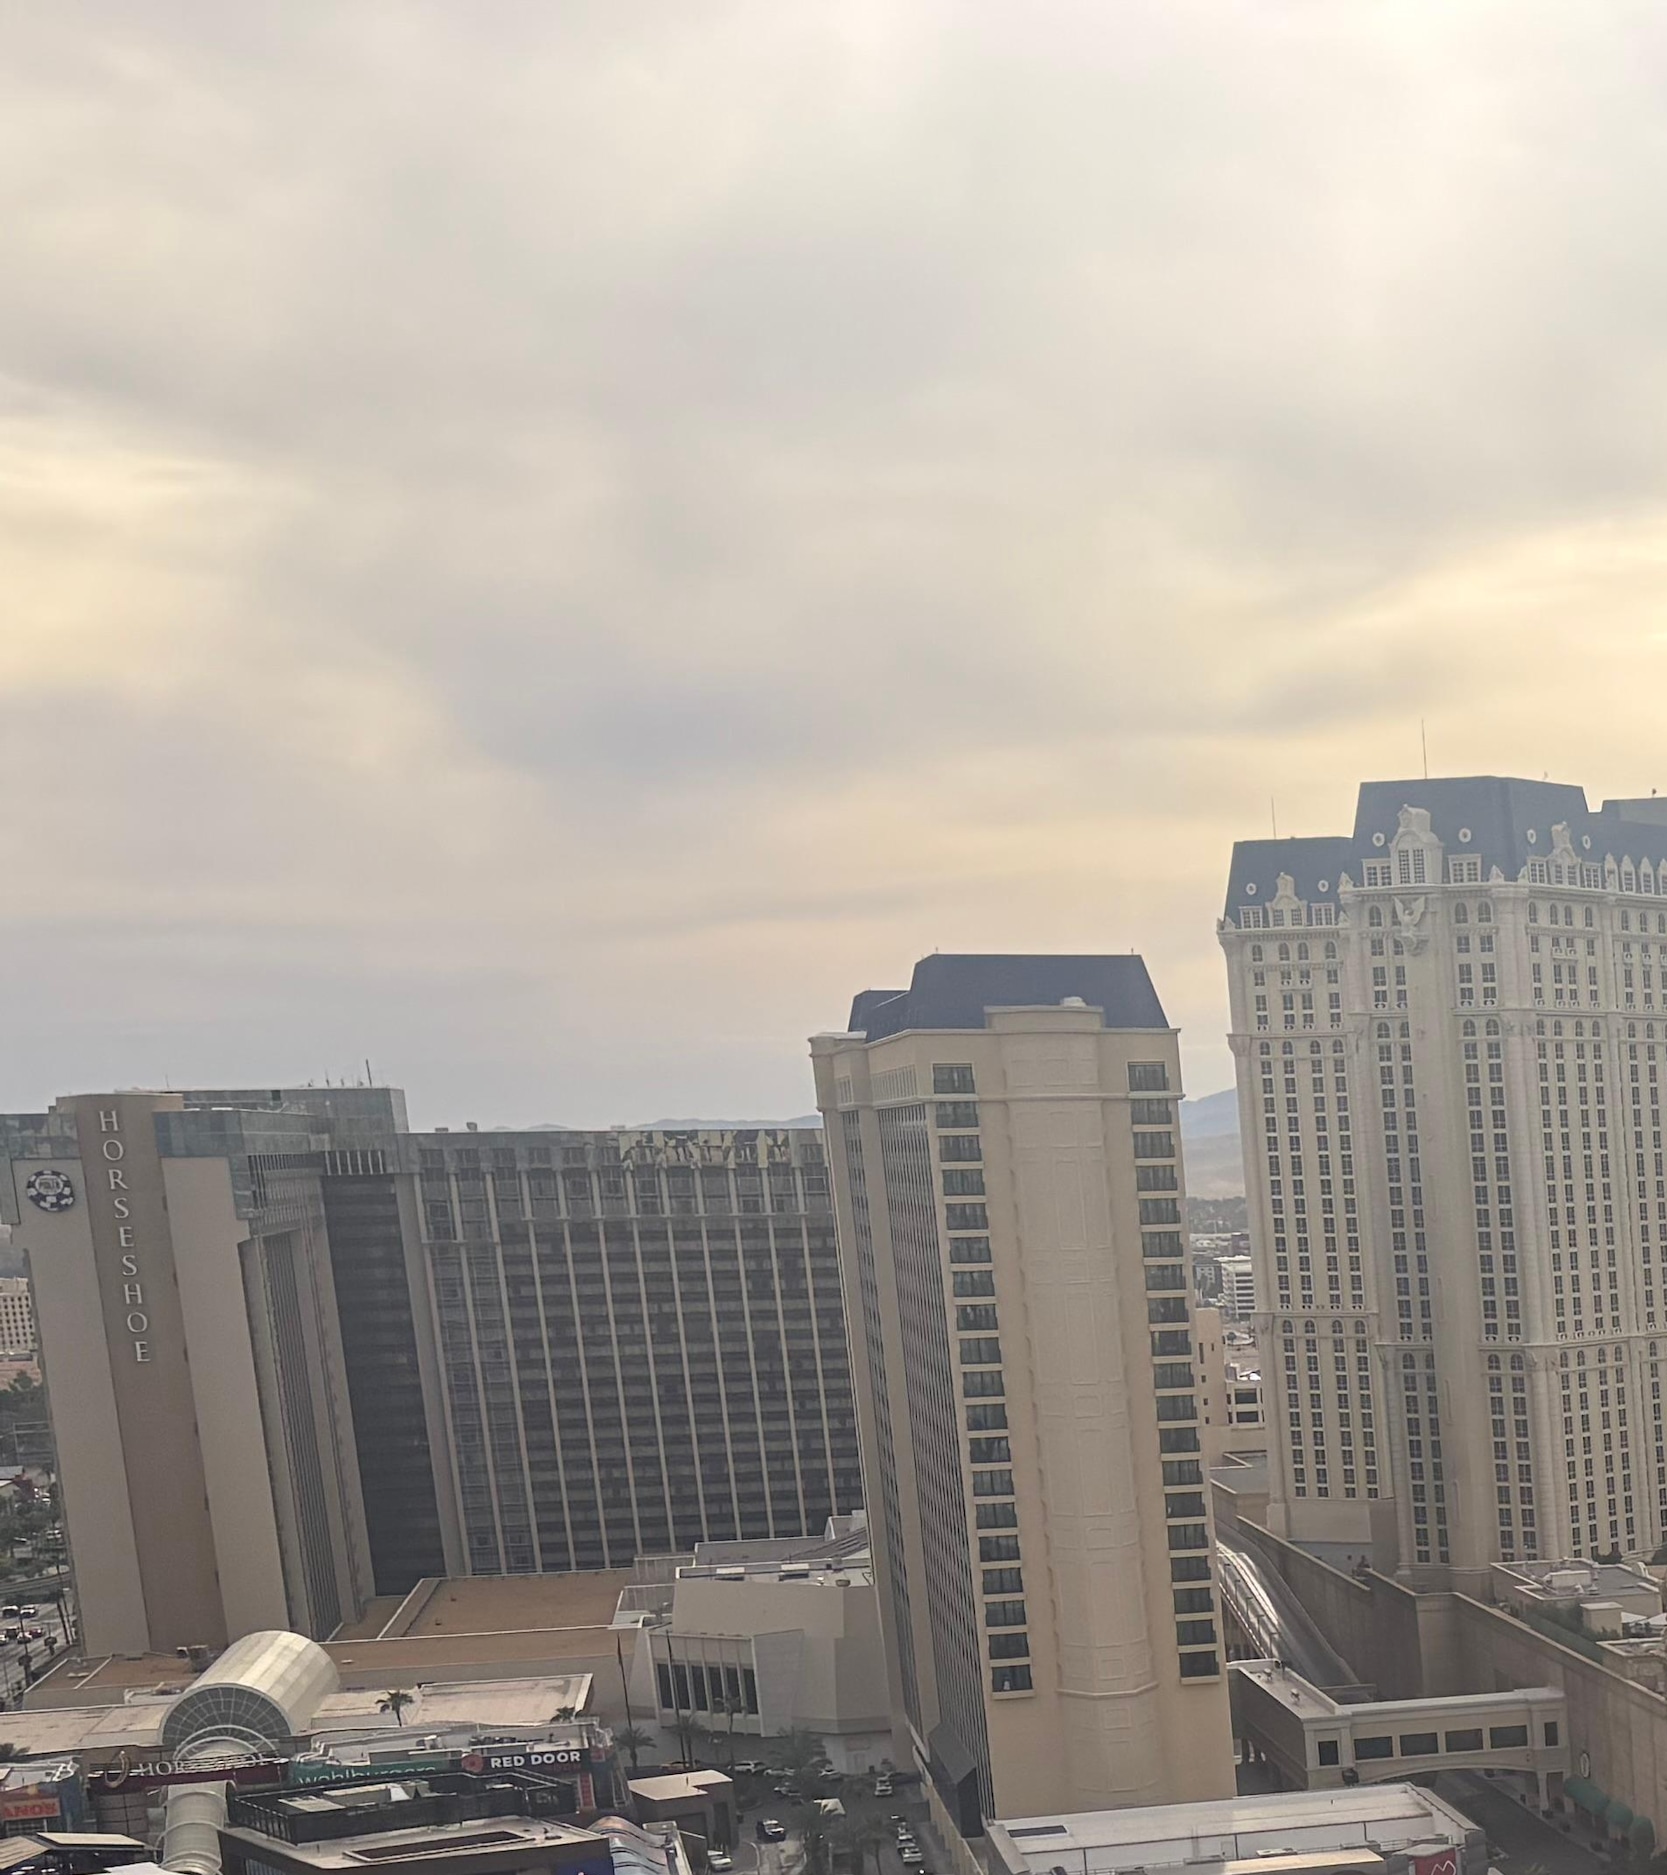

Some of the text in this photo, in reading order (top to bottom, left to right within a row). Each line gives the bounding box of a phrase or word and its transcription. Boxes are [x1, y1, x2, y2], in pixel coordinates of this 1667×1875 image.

[99, 1110, 151, 1363] HORSESHOE
[490, 1751, 581, 1769] RED DOOR
